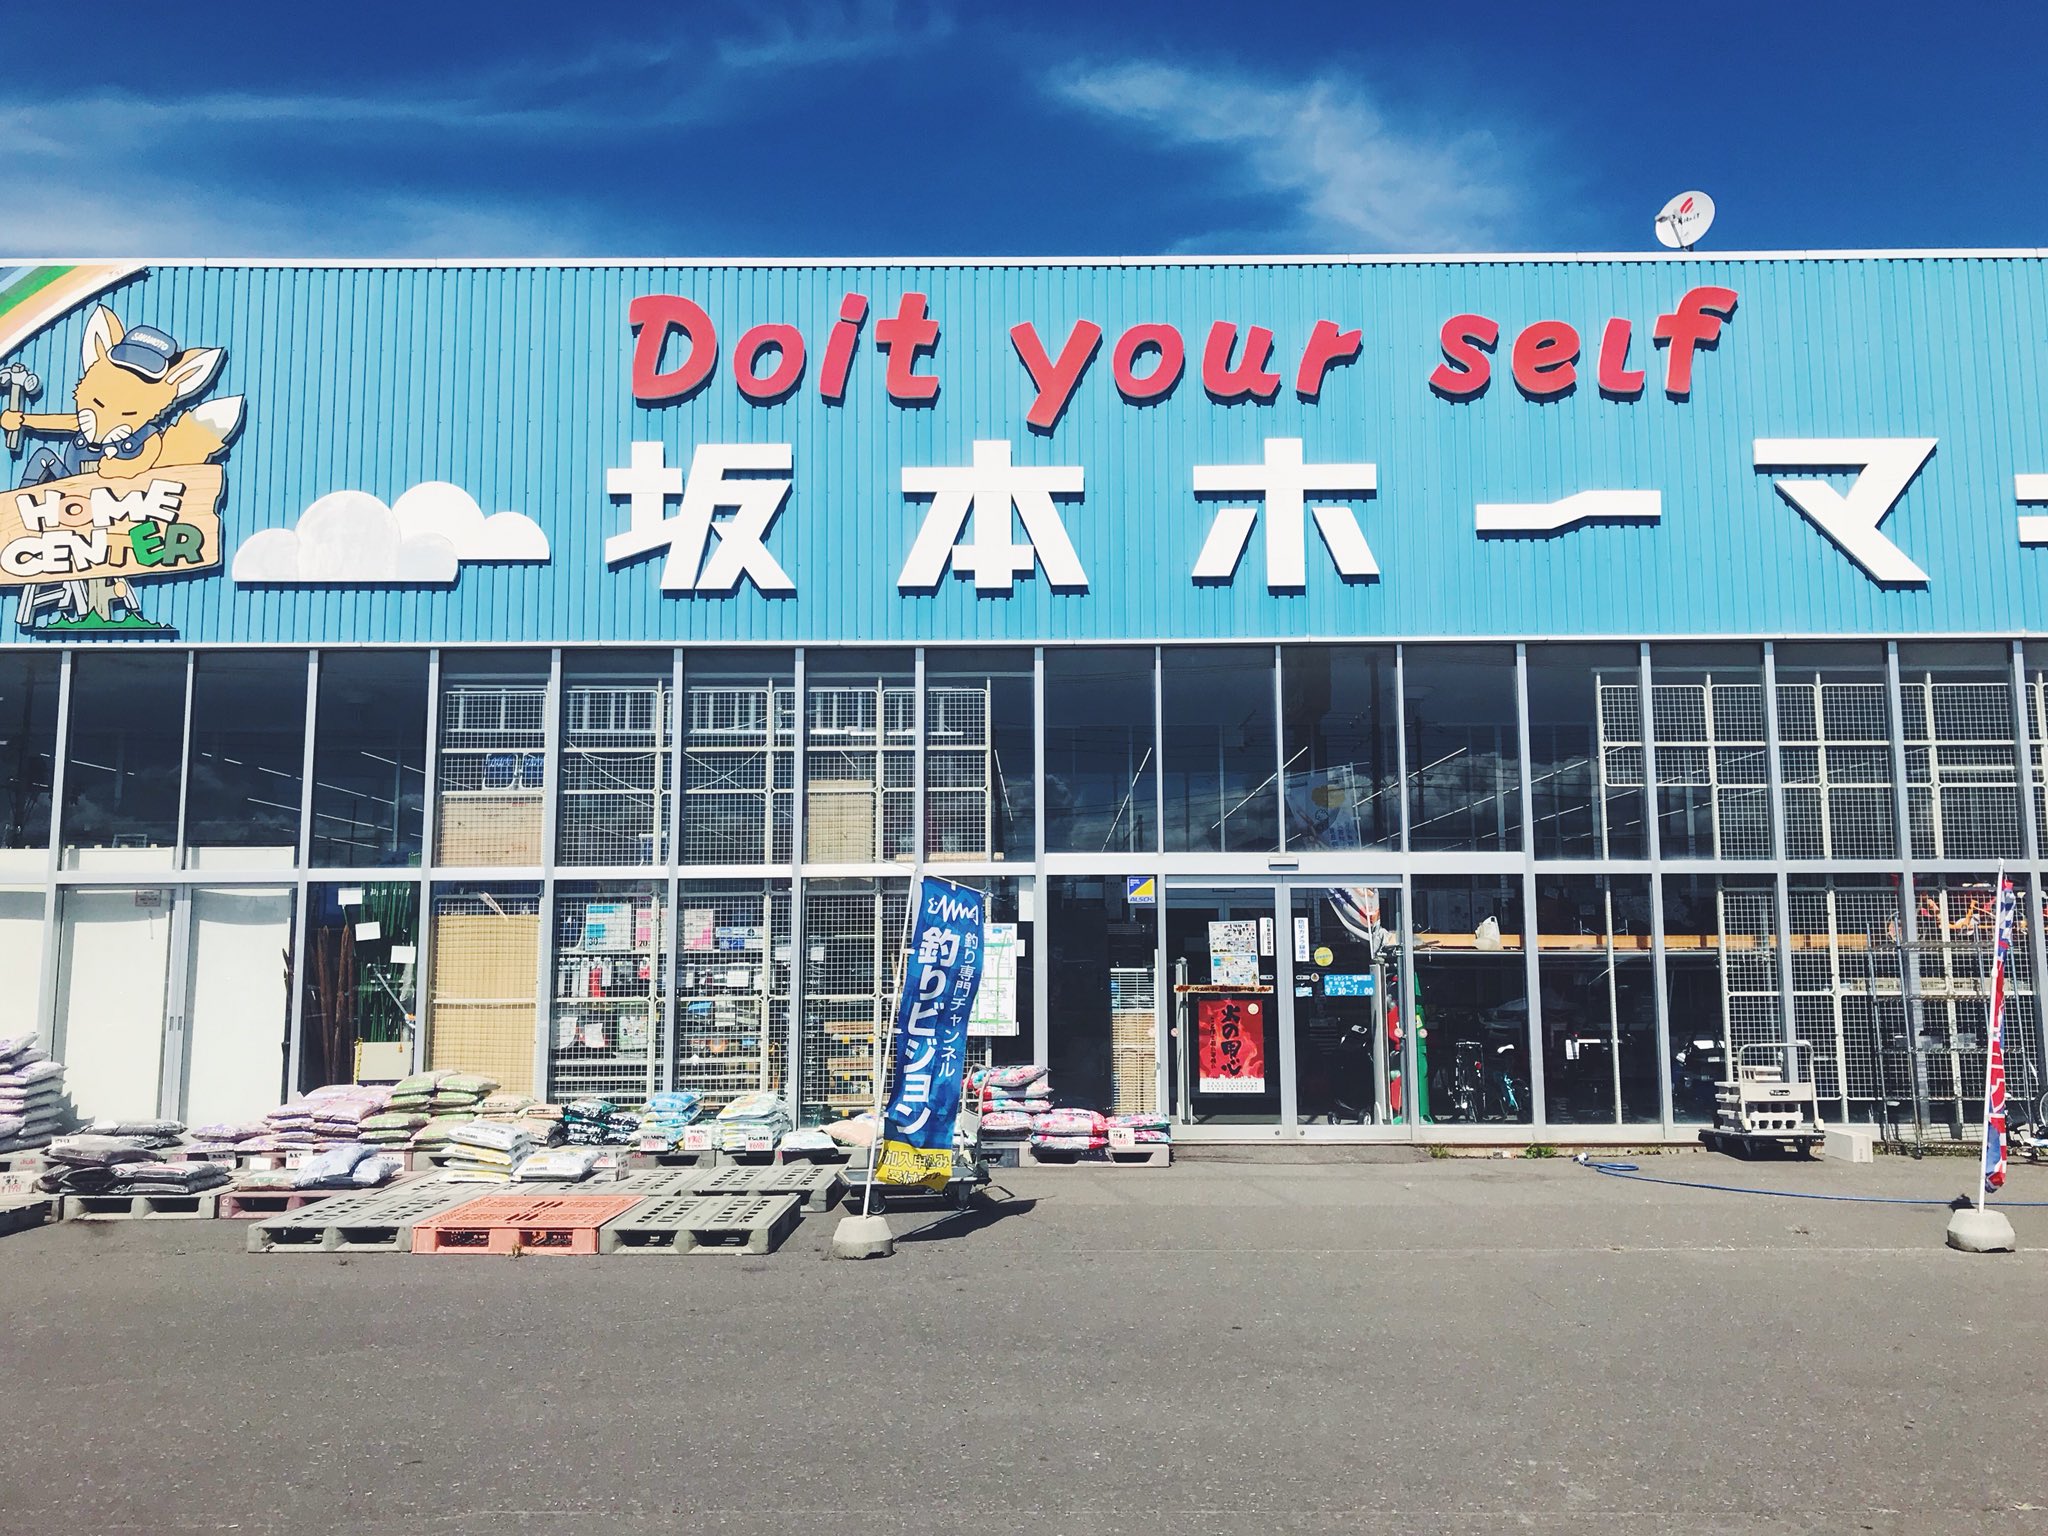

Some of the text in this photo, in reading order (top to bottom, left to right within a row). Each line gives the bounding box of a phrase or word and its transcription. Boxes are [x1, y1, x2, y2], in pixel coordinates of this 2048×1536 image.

[1009, 318, 1363, 428] your
[1428, 285, 1739, 396] self
[0, 520, 205, 578] CENTER
[15, 478, 187, 532] HOME
[604, 437, 2048, 591] 坂本ホーマ
[895, 925, 961, 1136] 釣りビジョン
[937, 931, 980, 1078] 釣り専門チャンネル
[1220, 1004, 1242, 1077] 火の用心
